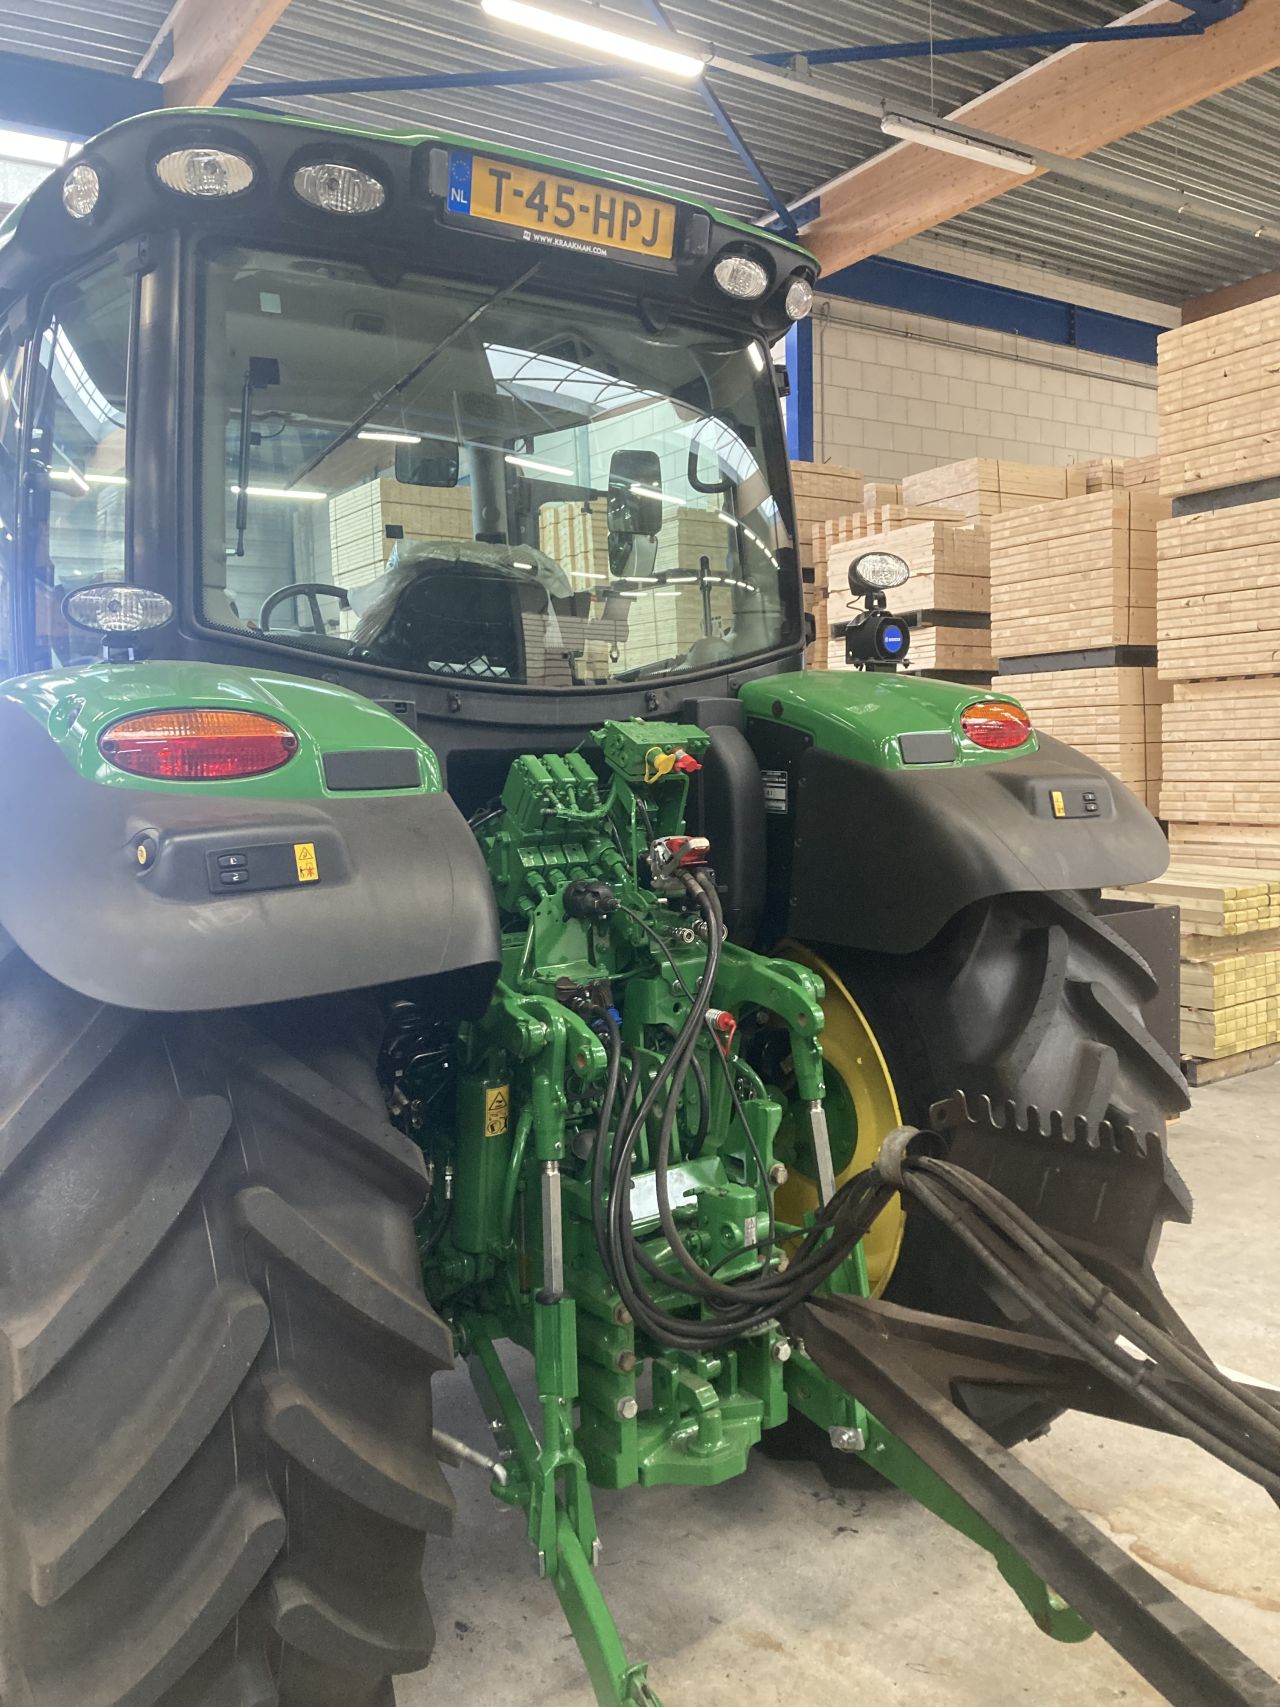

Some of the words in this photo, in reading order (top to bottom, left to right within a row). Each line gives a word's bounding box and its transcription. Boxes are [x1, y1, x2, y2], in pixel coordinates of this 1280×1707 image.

[451, 187, 468, 204] NL
[489, 168, 660, 247] T-45-HPJ
[533, 233, 607, 256] WWW.KRAAKMAN.COM
